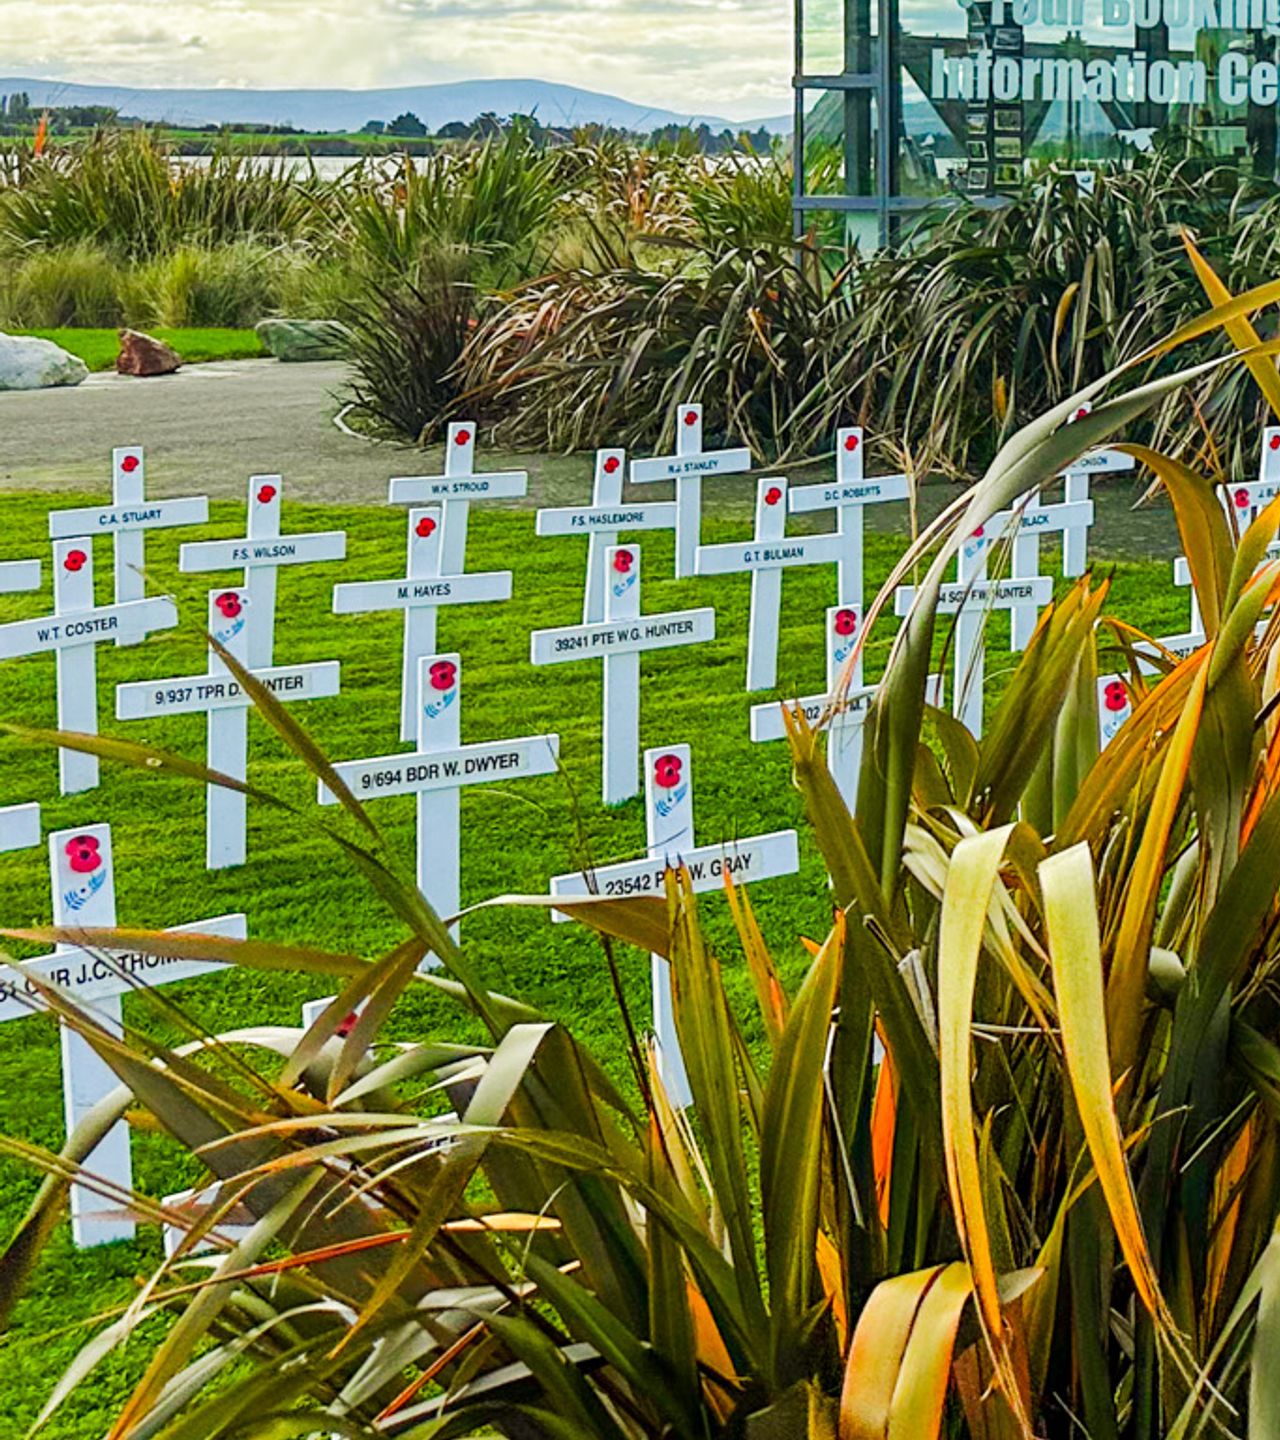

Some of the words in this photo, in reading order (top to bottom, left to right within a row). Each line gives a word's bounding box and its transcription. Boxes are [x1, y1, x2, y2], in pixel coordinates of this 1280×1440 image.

[930, 48, 1207, 104] Information
[453, 481, 490, 494] STROUD
[842, 485, 881, 500] ROBERTS
[121, 509, 162, 523] STUART
[589, 511, 645, 526] HASLEMORE
[253, 544, 296, 559] WILSON
[763, 546, 804, 561] BULMAN
[413, 582, 452, 599] HAYES
[65, 616, 118, 638] COSTER
[592, 631, 615, 647] PTE
[645, 620, 694, 639] HUNTER
[155, 688, 193, 706] 9/937
[196, 684, 225, 701] TPR
[361, 769, 402, 790] 9/694
[406, 763, 440, 783] BDR
[443, 760, 461, 777] W.
[464, 752, 520, 775] DWYER
[606, 873, 651, 896] 23542
[688, 862, 707, 881] W.
[710, 853, 752, 876] GRAY
[76, 959, 114, 985] J.C.
